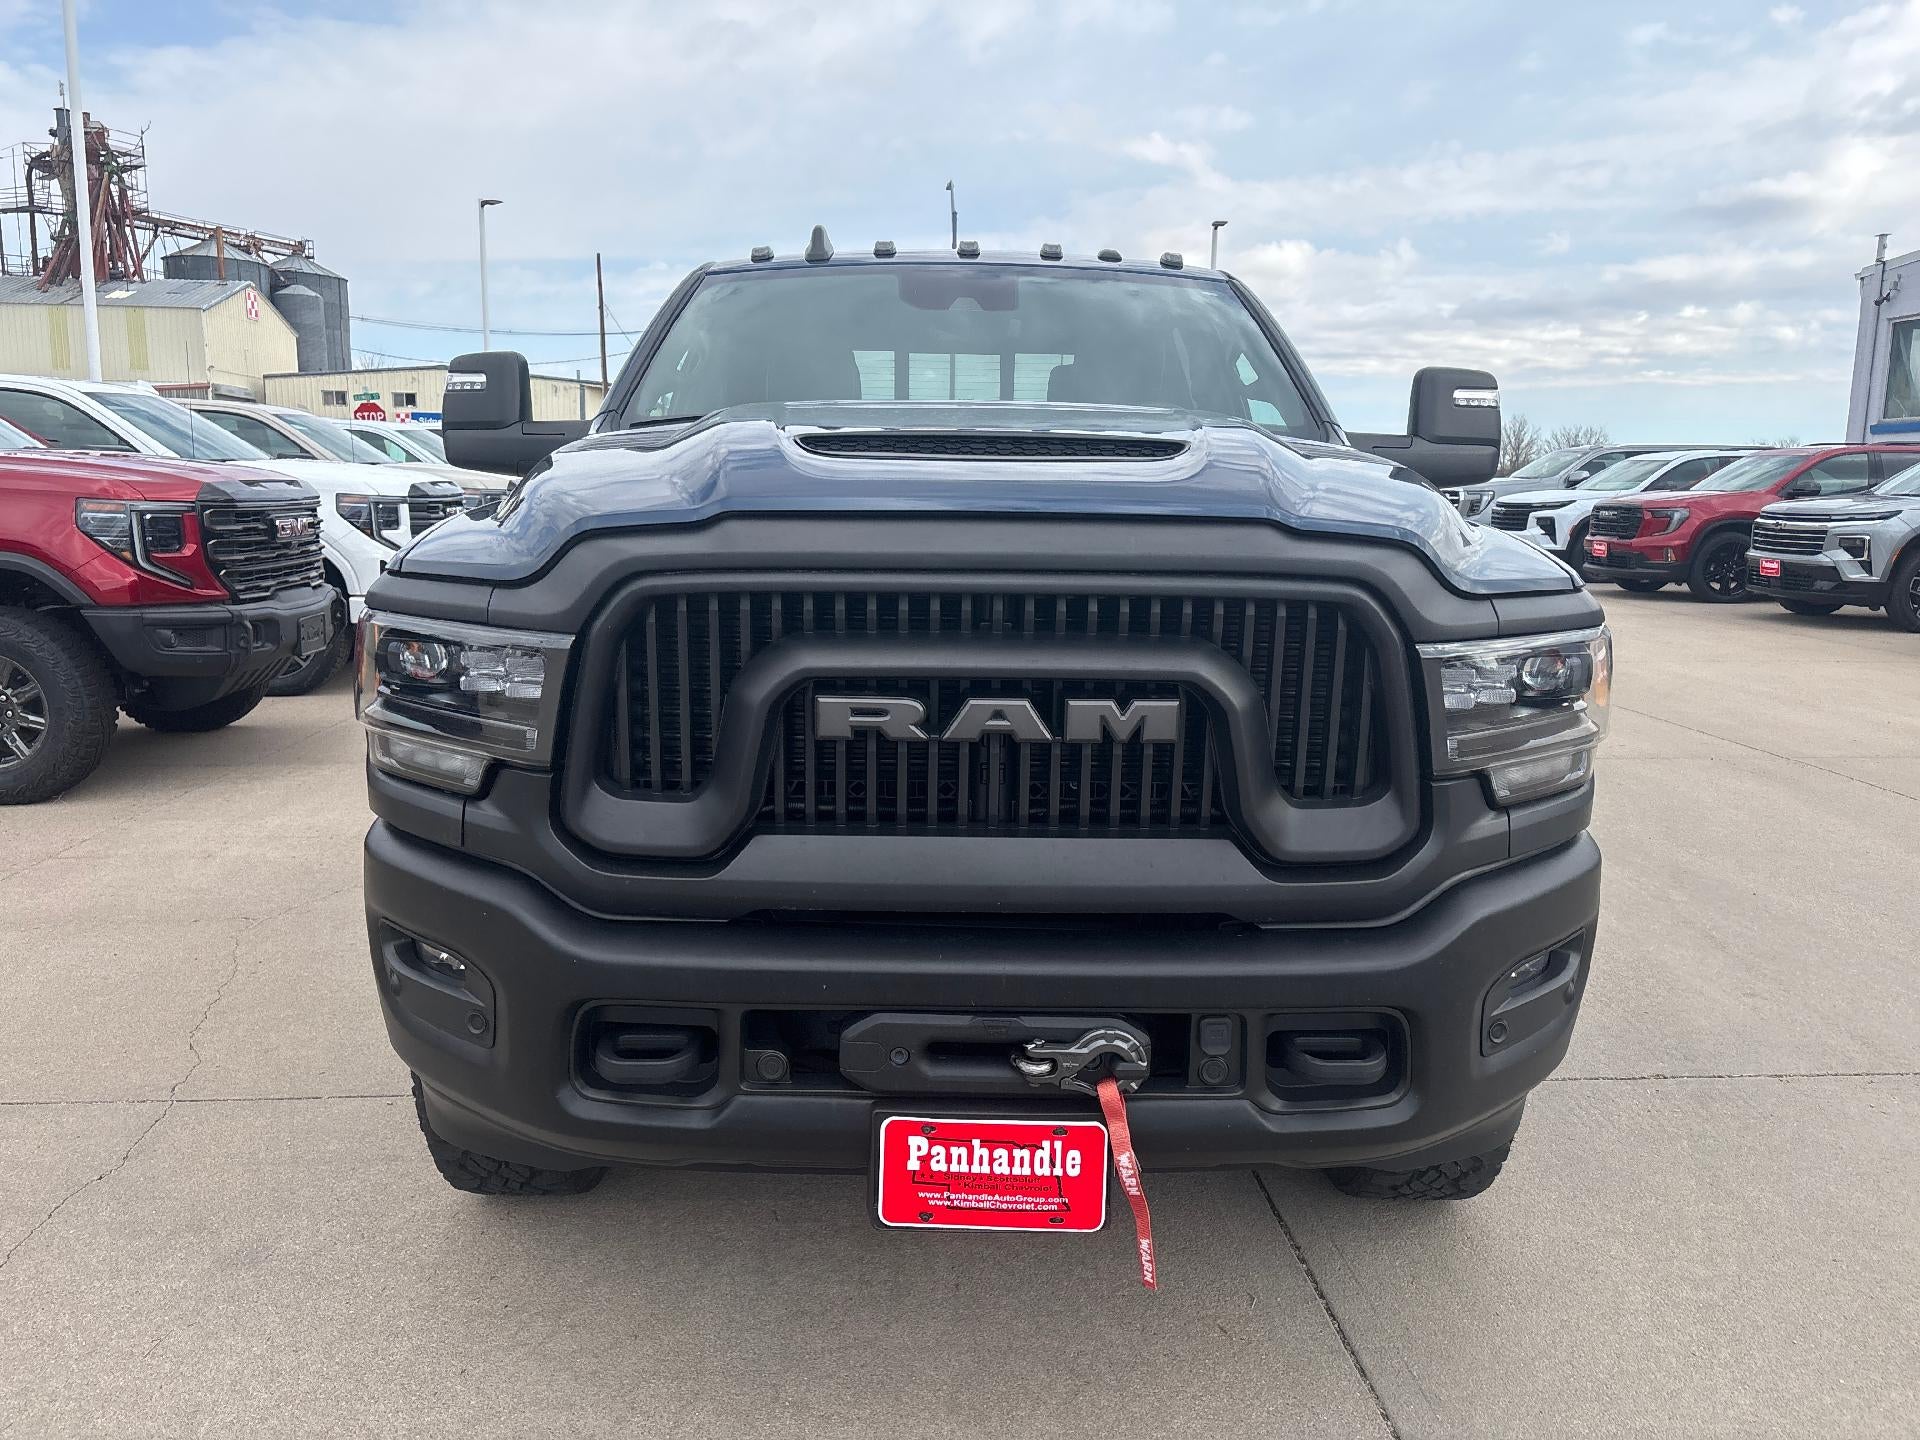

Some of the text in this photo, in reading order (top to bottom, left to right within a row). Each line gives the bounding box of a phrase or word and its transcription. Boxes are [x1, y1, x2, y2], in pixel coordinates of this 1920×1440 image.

[355, 411, 385, 421] STOP
[275, 517, 316, 538] GMC
[814, 694, 1181, 744] RAM
[907, 1136, 1082, 1177] Panhandle
[943, 1173, 977, 1183] Sidney
[1118, 1151, 1141, 1196] WARN
[963, 1182, 1053, 1193] Kimball Chevrolet
[917, 1191, 1069, 1205] www.PanhandleAutoGroup.com
[928, 1199, 1058, 1211] www.KimballChevrolet.com
[1140, 1238, 1154, 1284] WARN
